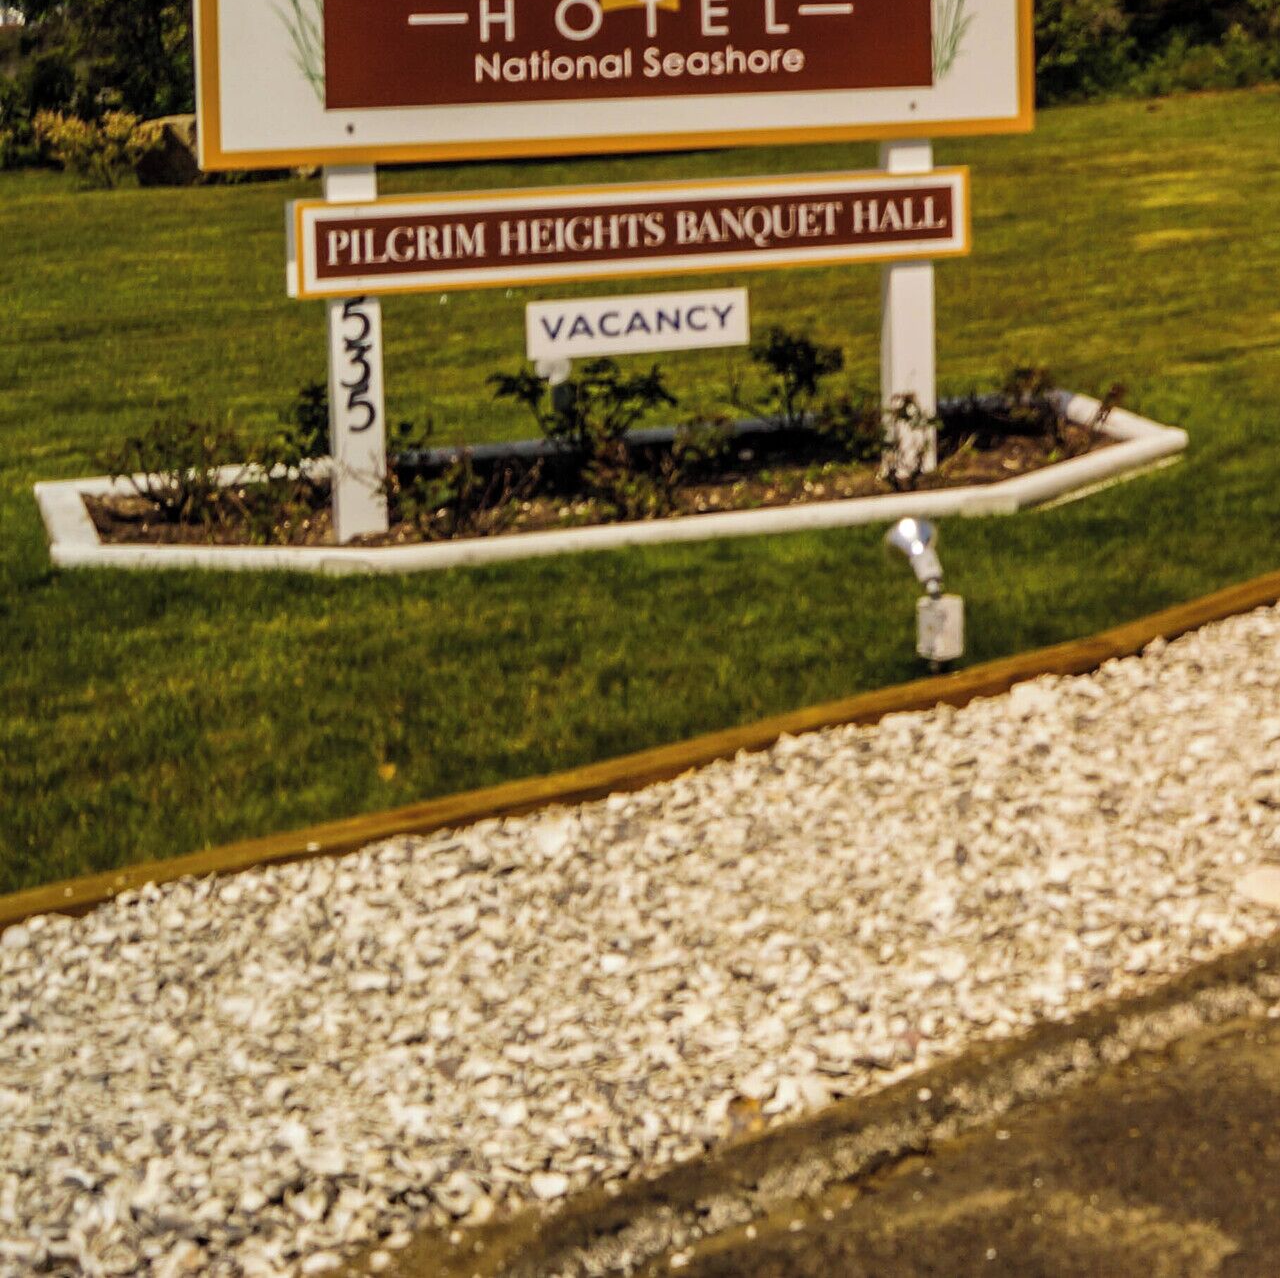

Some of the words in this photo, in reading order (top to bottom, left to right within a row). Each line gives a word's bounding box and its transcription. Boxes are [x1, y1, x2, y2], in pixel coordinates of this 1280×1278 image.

[475, 47, 632, 83] National
[643, 45, 805, 79] Seashore
[327, 221, 486, 266] PILGRIM
[500, 211, 665, 256] HEIGHTS
[676, 203, 841, 250] BANQUET
[852, 196, 946, 232] HALL
[540, 303, 735, 343] VACANCY
